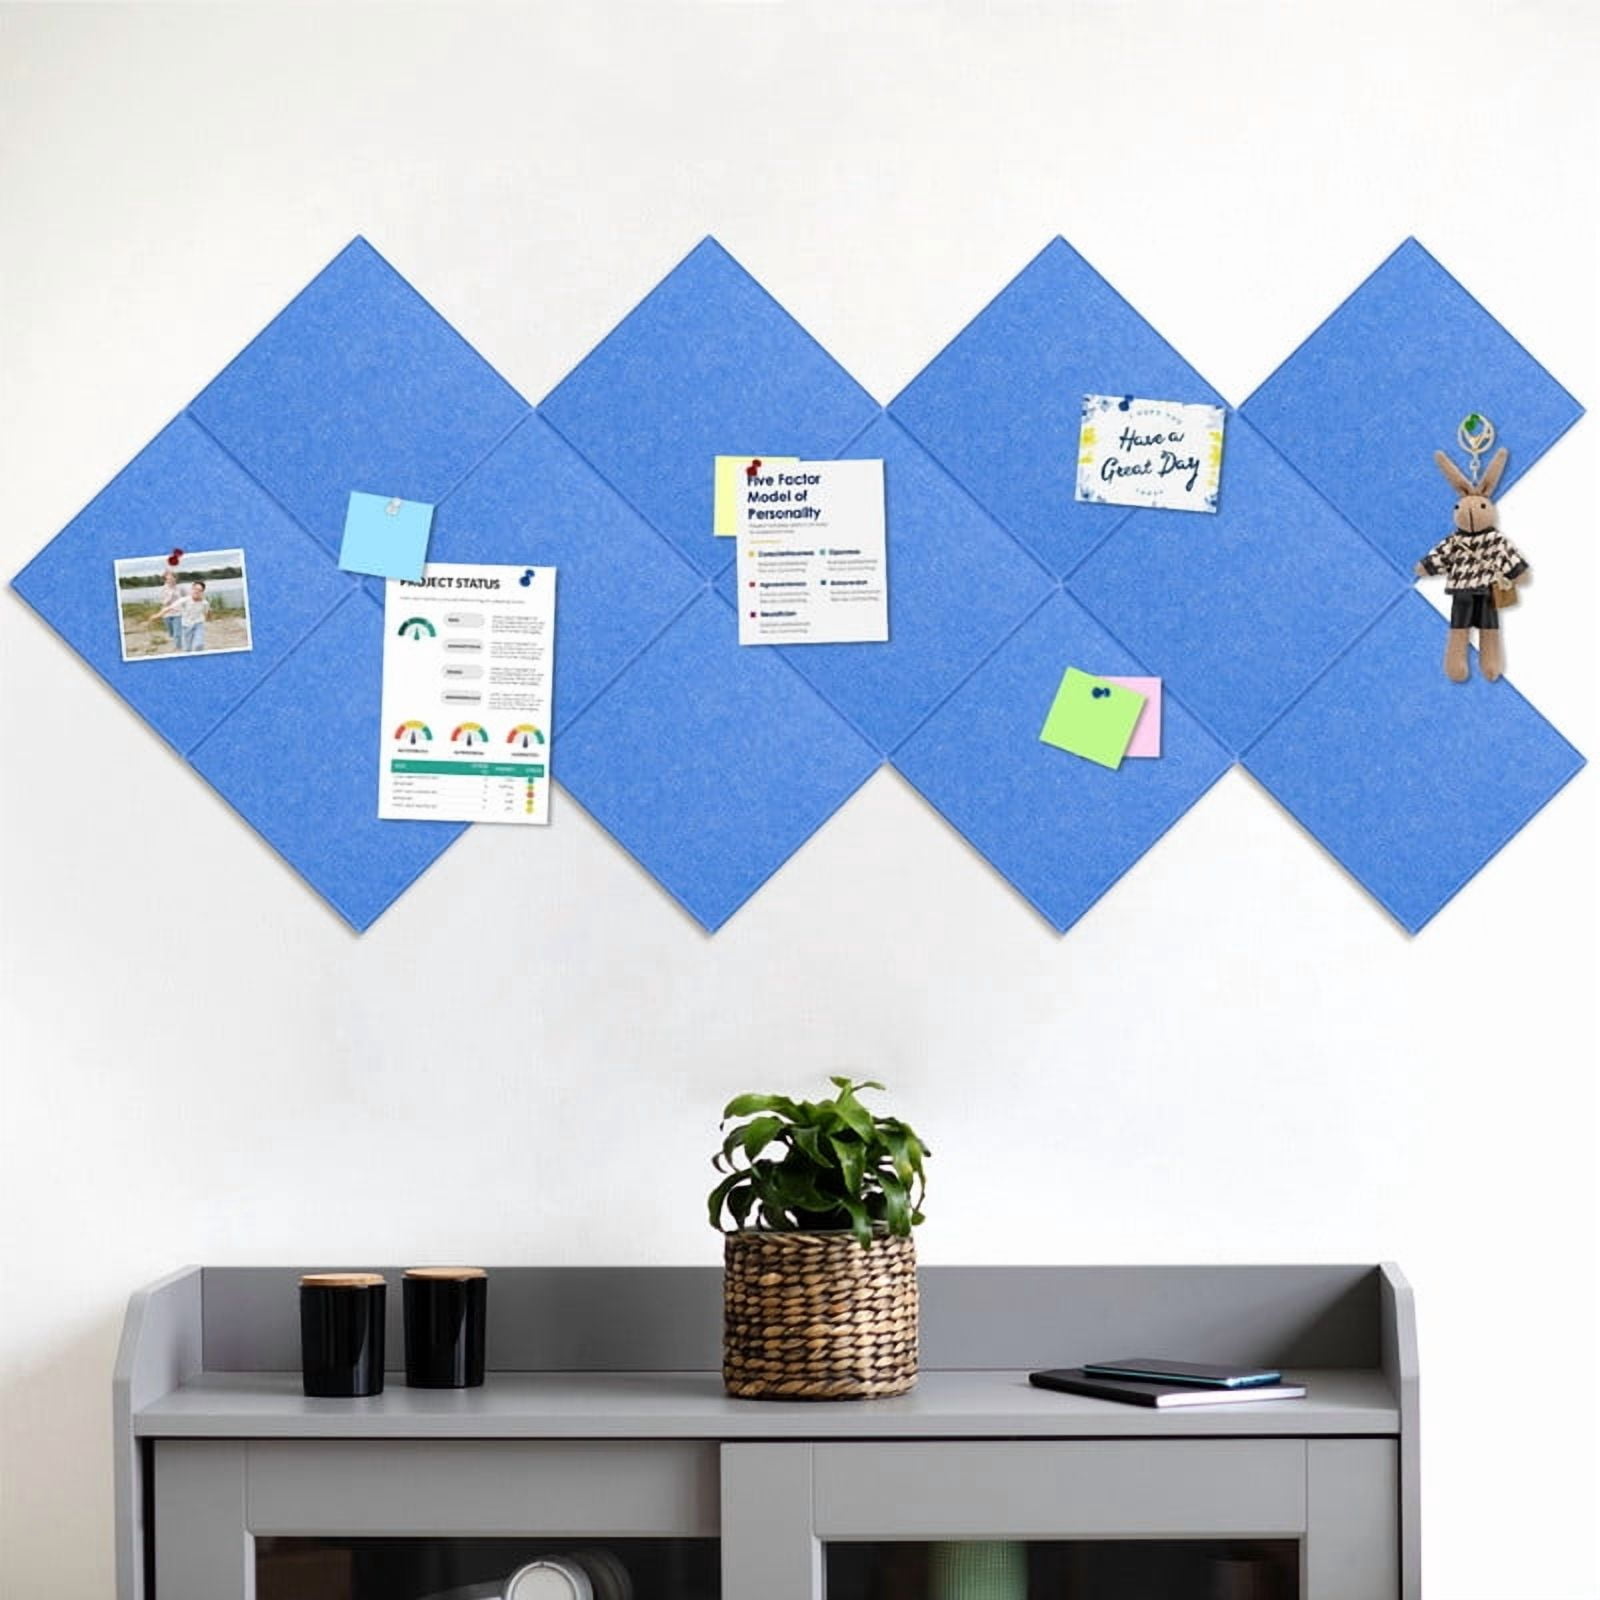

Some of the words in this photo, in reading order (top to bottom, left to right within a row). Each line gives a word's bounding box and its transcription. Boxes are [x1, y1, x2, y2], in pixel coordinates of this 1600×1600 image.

[1119, 426, 1165, 452] Have
[1168, 431, 1185, 443] a
[1100, 456, 1152, 484] Great
[1158, 450, 1200, 492] Day
[747, 474, 774, 487] Five
[778, 473, 821, 485] Factor
[747, 490, 791, 503] Model
[794, 489, 808, 502] of
[748, 506, 821, 521] Personality
[456, 577, 501, 590] STATUS
